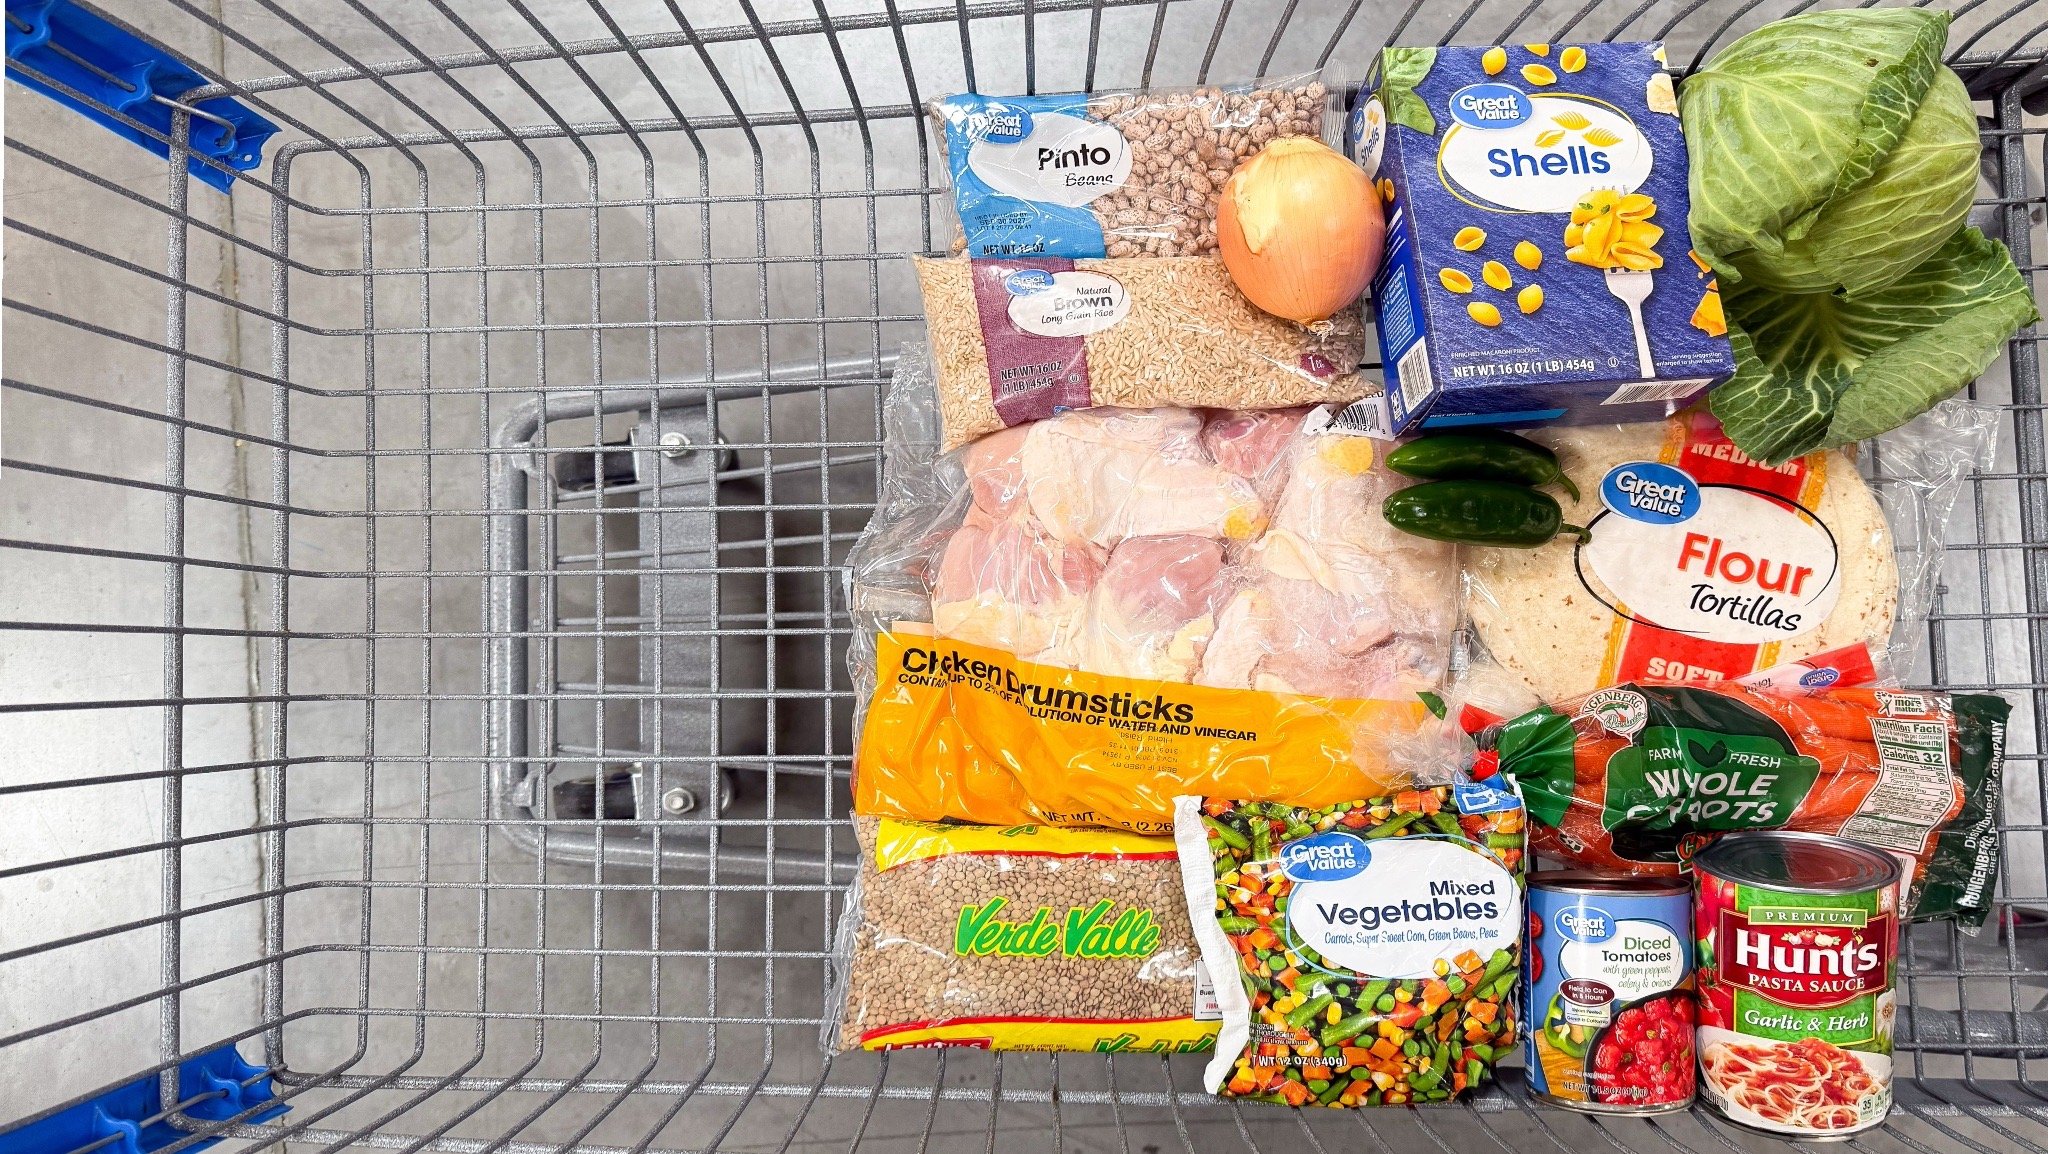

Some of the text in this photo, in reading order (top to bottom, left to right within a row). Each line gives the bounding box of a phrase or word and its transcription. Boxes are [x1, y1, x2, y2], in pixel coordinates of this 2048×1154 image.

[1460, 94, 1518, 111] Great
[1475, 109, 1520, 120] Value
[1039, 144, 1110, 170] Pinto
[1487, 146, 1611, 177] Shells
[1065, 173, 1114, 187] Beans
[983, 245, 999, 254] NET
[1001, 244, 1015, 254] WT
[1033, 243, 1045, 253] OZ
[1011, 274, 1045, 286] Great
[1077, 285, 1111, 295] Natural
[1054, 296, 1113, 311] Brown
[1041, 308, 1114, 324] Long Grain Rice
[1001, 361, 1063, 380] NET WT 16 OZ
[1453, 359, 1595, 378] NET WT 16 OZ (1 LB) 454g
[1002, 376, 1055, 394] (1 LB) 454g
[1616, 471, 1687, 505] Great
[1630, 492, 1681, 516] Value
[1677, 532, 1813, 596] Flour
[1691, 584, 1801, 631] Tortillas
[1647, 657, 1724, 686] SOFT
[1807, 674, 1834, 685] Great
[902, 647, 1194, 723] Chcken Drumsticks
[897, 674, 949, 688] CONTAIN
[948, 673, 965, 683] UP
[968, 677, 982, 689] TO
[984, 683, 999, 696] 2%
[1000, 691, 1012, 701] OF
[1025, 703, 1083, 723] LUTION
[1086, 714, 1105, 726] OF
[1109, 718, 1156, 732] WATER
[1159, 723, 1191, 736] AND
[1194, 727, 1257, 742] VINEGAR
[1584, 692, 1643, 713] NGENBERG
[1895, 699, 1921, 707] more
[1876, 719, 1943, 733] Nutrition Facts
[1649, 748, 1781, 768] FARM FRESH
[1882, 749, 1943, 764] Calories 32
[1990, 719, 2004, 779] COMPANY
[1157, 765, 1178, 773] BEST
[1645, 768, 1779, 799] WHOLE
[1042, 811, 1067, 822] NET
[1627, 798, 1779, 823] CROTS
[1965, 777, 1993, 849] Distributed by
[1289, 841, 1355, 861] Great
[1307, 857, 1356, 872] Value
[1963, 837, 1991, 908] HUNGENBERG
[1429, 880, 1495, 897] Mixed
[1317, 897, 1499, 930] Vegetables
[1561, 912, 1605, 931] Great
[1765, 911, 1853, 922] PREMIUM
[955, 896, 1163, 960] Verde Valle
[1571, 927, 1605, 938] Value
[1325, 927, 1499, 948] Carrots, Super Sweet Corn, Green Beans, Peas
[1624, 936, 1671, 950] Diced
[1602, 950, 1671, 962] Tomatoes
[1736, 927, 1878, 977] Hunt's
[1603, 964, 1620, 974] with
[1622, 965, 1643, 978] green
[1618, 980, 1640, 992] celery
[1651, 979, 1672, 988] onions
[1748, 973, 1865, 993] PASTA SAUCE
[1744, 1009, 1869, 1032] Garlic & Herb
[1259, 1054, 1347, 1068] WT 12 OZ (340g)
[1562, 1081, 1575, 1091] NET
[1577, 1083, 1591, 1094] WT
[1862, 1098, 1871, 1111] 35
